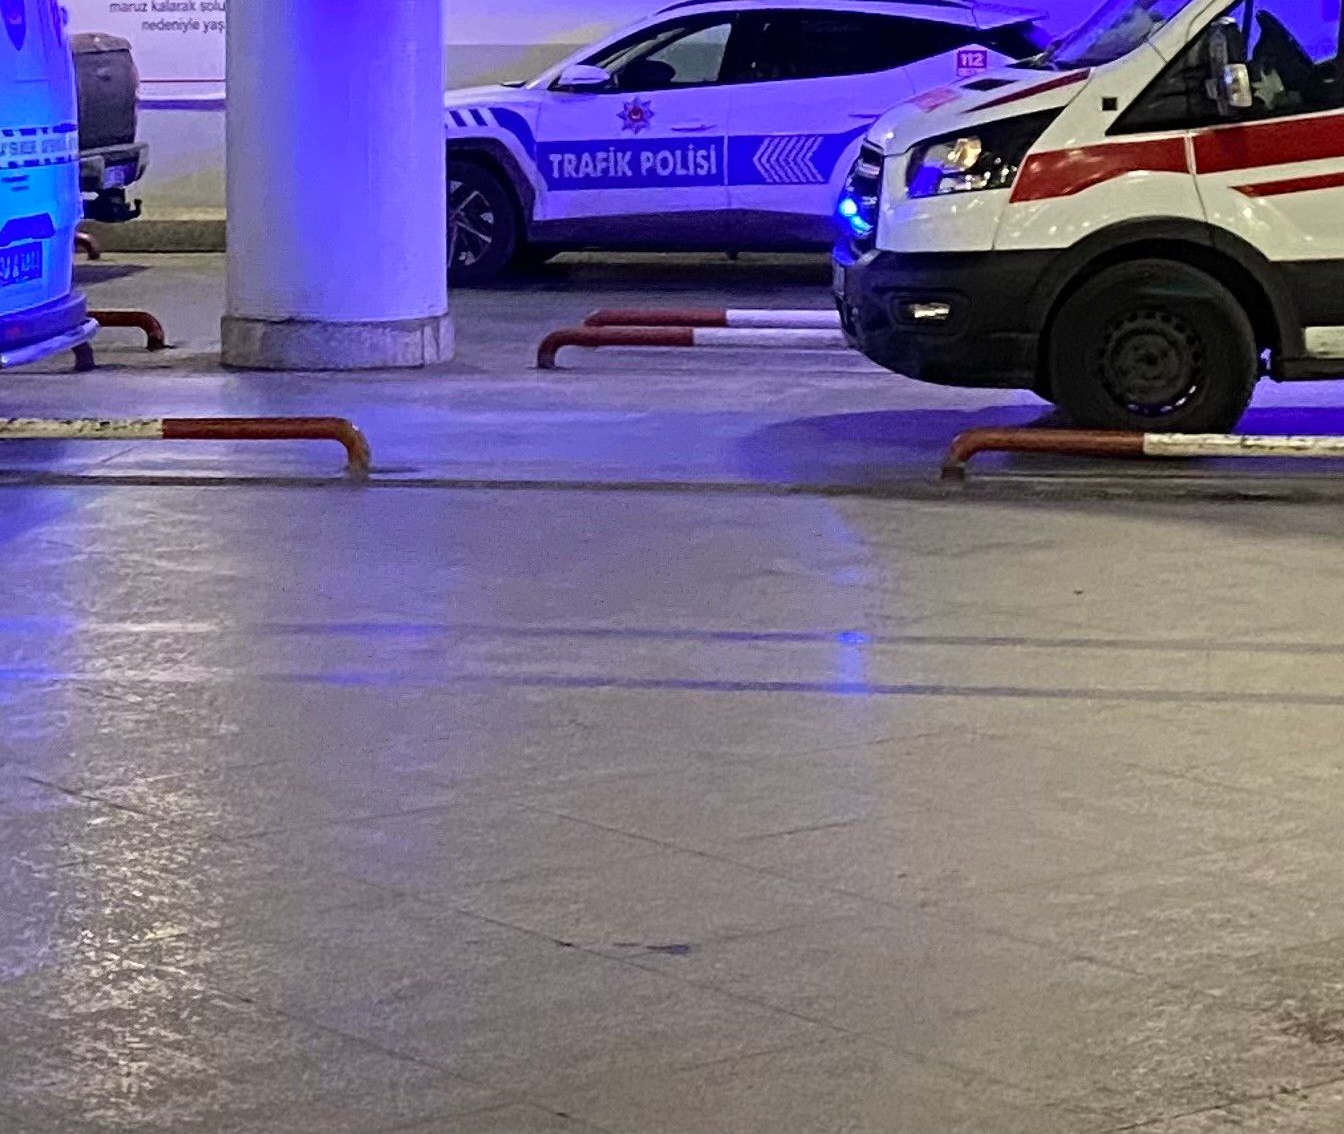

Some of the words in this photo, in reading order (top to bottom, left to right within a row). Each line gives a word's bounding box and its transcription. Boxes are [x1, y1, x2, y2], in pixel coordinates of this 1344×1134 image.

[109, 2, 147, 13] maruz
[152, 0, 196, 12] kalarak
[142, 18, 199, 34] nedeniyle
[960, 53, 985, 67] 112
[549, 146, 633, 178] TRAFİK
[641, 143, 717, 177] POLİSİ
